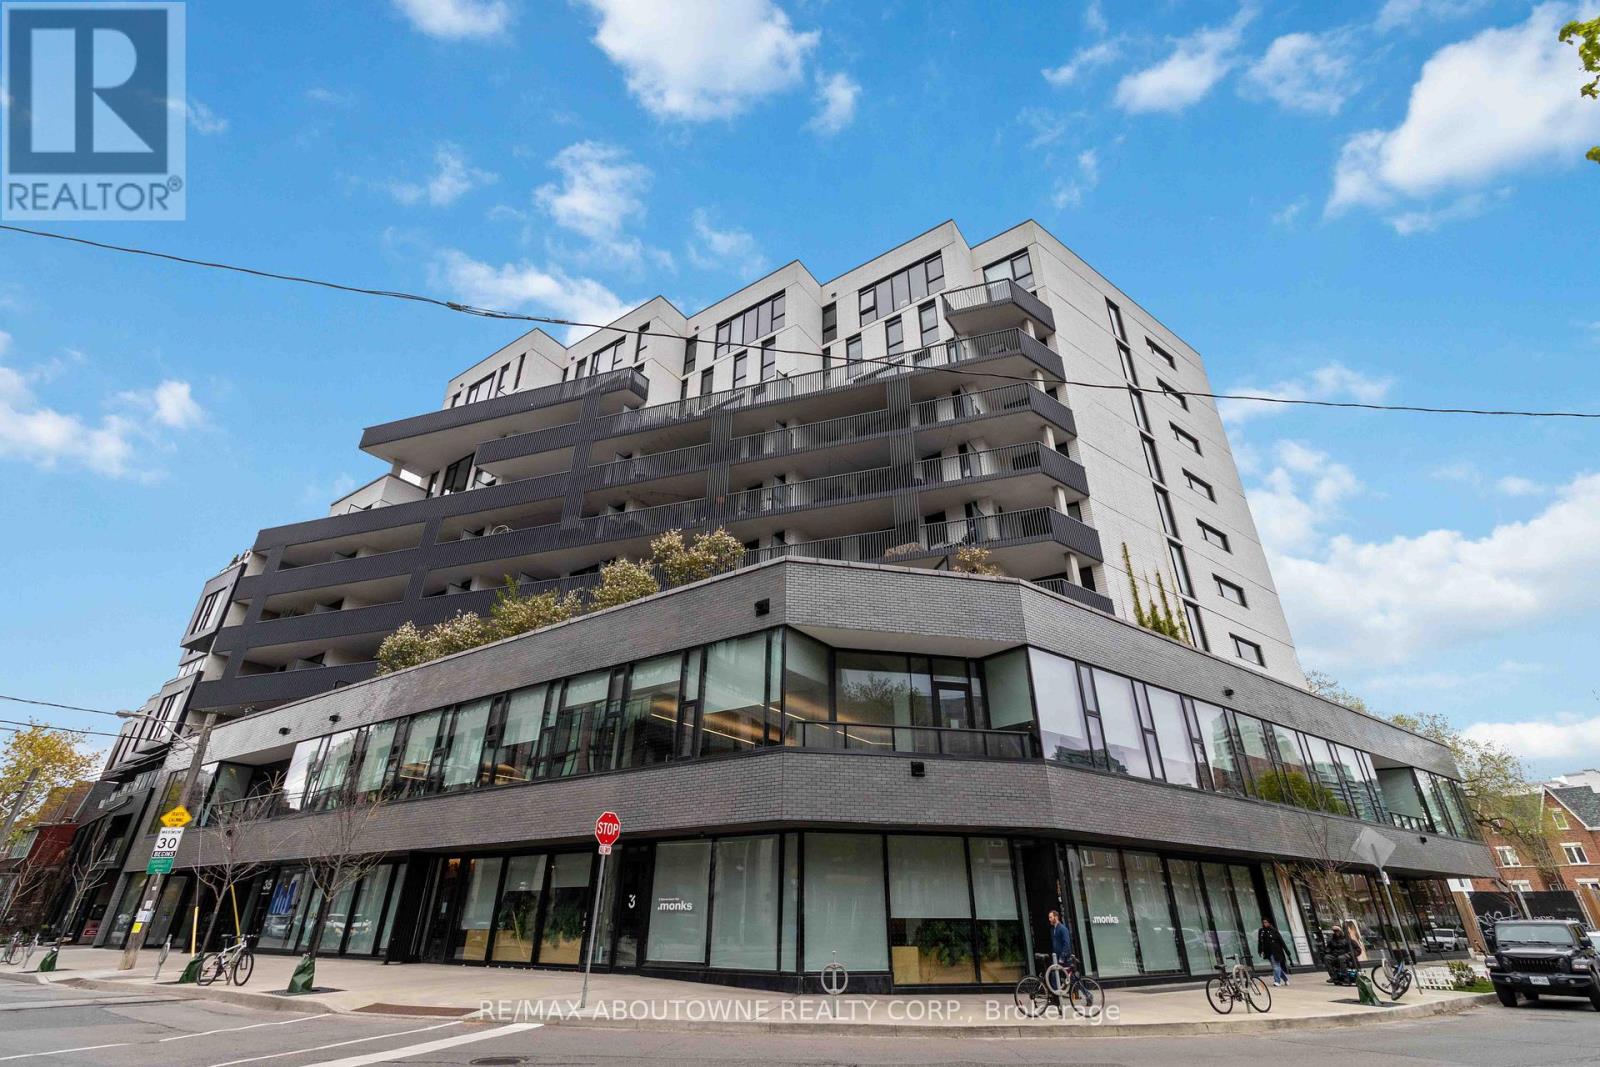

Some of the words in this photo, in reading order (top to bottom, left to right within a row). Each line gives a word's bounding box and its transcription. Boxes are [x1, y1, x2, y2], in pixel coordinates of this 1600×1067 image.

[597, 821, 619, 836] STOP
[157, 837, 177, 849] 30
[628, 894, 636, 909] 3
[657, 900, 693, 911] .monks
[1092, 913, 1119, 924] .monks
